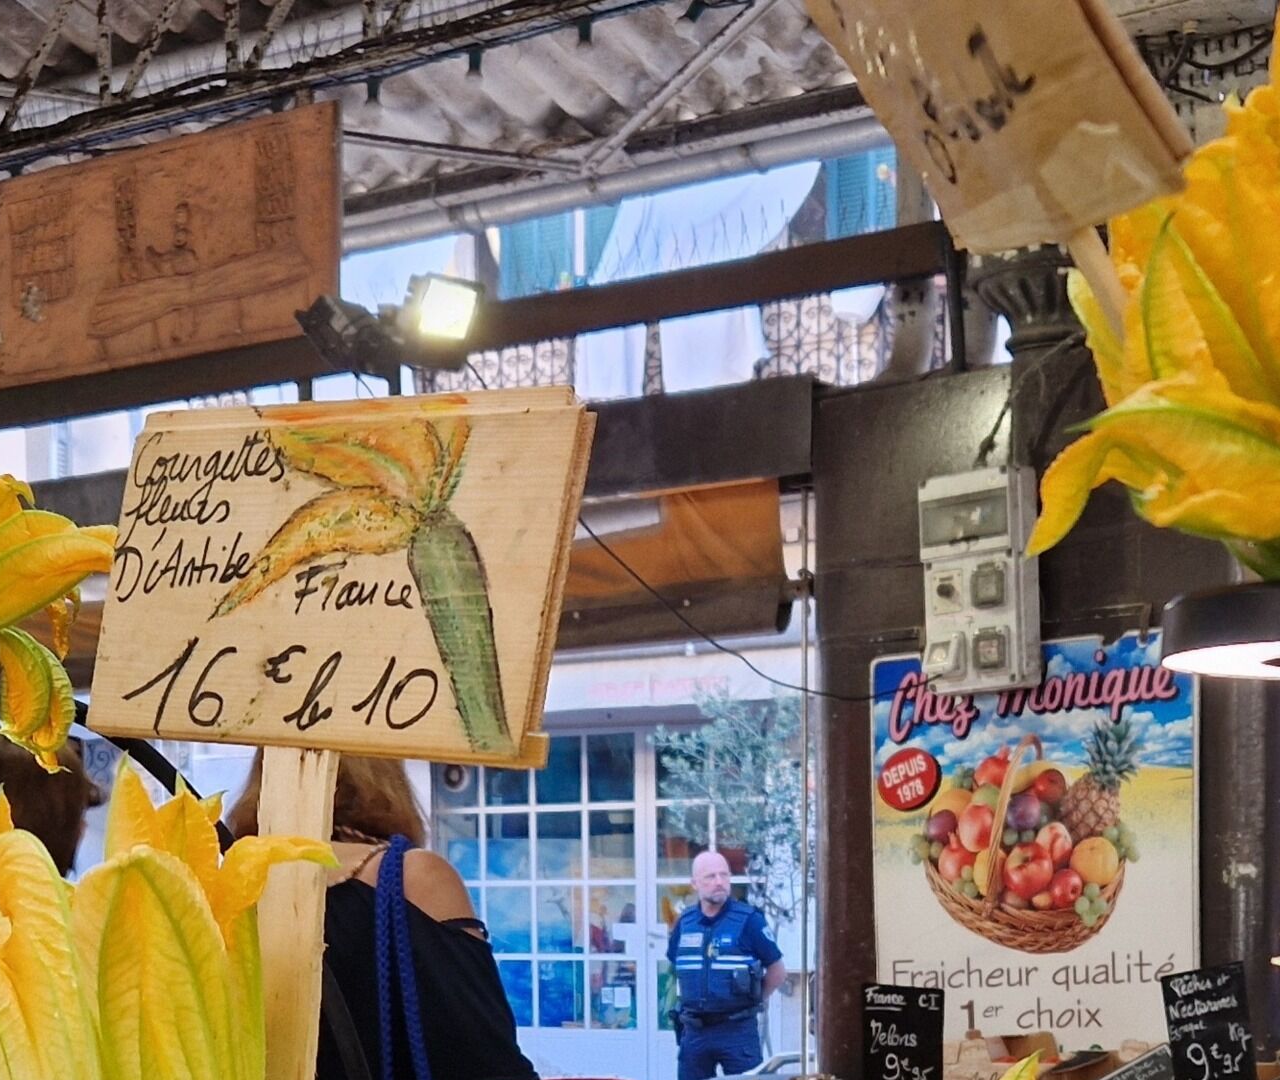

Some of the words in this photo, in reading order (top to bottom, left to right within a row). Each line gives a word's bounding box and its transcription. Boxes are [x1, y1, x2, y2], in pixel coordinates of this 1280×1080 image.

[132, 431, 287, 493] Courgettes
[123, 471, 233, 542] fleurs
[292, 558, 415, 616] France
[122, 636, 238, 737] 16
[351, 655, 440, 731] 10
[882, 753, 928, 787] DEPUIS
[891, 957, 1039, 991] Fraicheur
[1052, 950, 1176, 992] qualité
[1016, 996, 1104, 1030] choix
